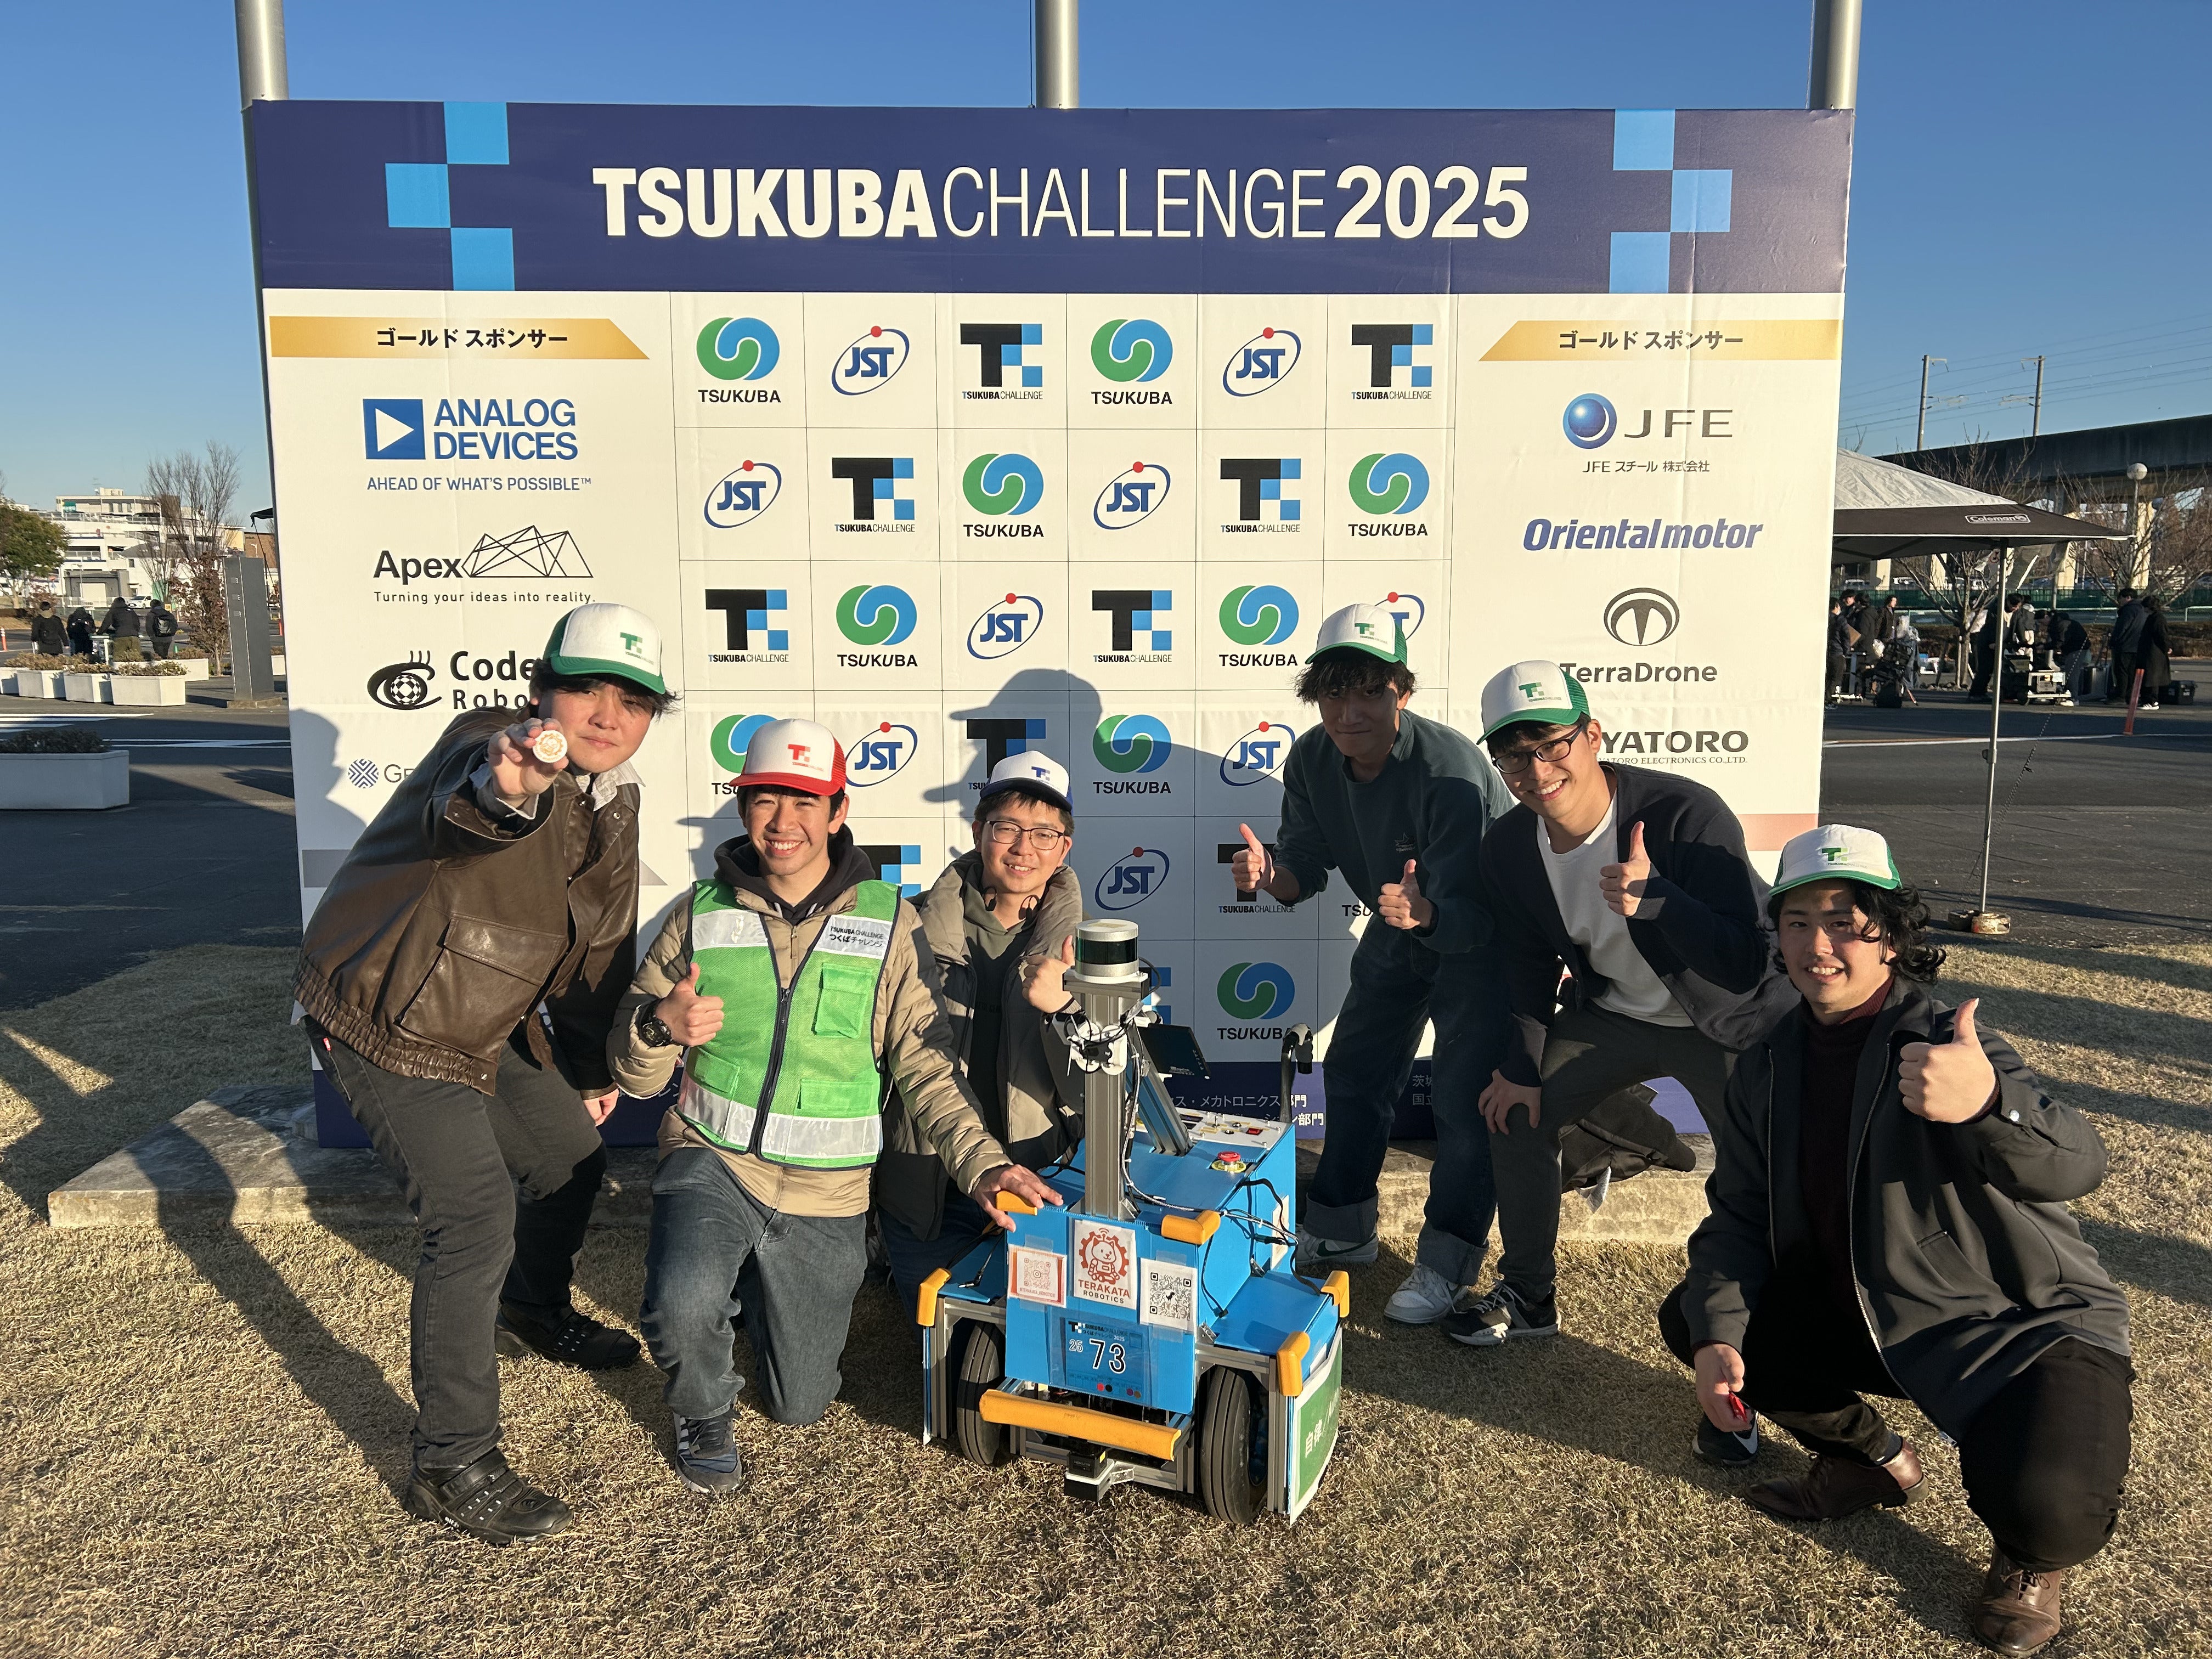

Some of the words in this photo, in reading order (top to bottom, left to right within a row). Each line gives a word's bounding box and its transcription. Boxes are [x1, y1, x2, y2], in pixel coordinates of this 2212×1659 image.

[1335, 165, 1528, 239] 2025
[845, 347, 894, 377] JST
[1236, 348, 1285, 379] JST
[698, 390, 781, 403] TSUKUBA
[1091, 392, 1172, 405] TSUKUBA
[434, 399, 575, 427] ANALOG
[1624, 410, 1733, 438] JFE
[434, 432, 578, 460] DEVICES
[1583, 462, 1610, 473] JFE
[1616, 462, 1657, 472] スチール
[1663, 461, 1709, 472] 株式会社
[368, 478, 417, 490] AHEAD
[423, 478, 442, 490] OF
[717, 481, 766, 511] JST
[1107, 483, 1155, 512] JST
[963, 525, 1043, 538] TSUKUBA
[1348, 524, 1427, 537] TSUKUBA
[374, 550, 462, 585] Apex
[374, 592, 427, 605] Turning
[435, 595, 464, 605] your
[471, 592, 507, 602] ideas
[514, 592, 539, 602] into
[980, 613, 1028, 642] JST
[450, 650, 534, 681] Code
[837, 655, 917, 667] TSUKUBA
[1219, 655, 1297, 667] TSUKUBA
[1560, 662, 1718, 682] TerraDrone
[854, 742, 902, 770] JST
[1233, 741, 1280, 769] JST
[1093, 782, 1171, 794] TSUKUBA
[1108, 866, 1154, 894] JST
[831, 926, 855, 934] TSUKUBA
[855, 929, 884, 939] CHALLENGE
[1079, 1279, 1130, 1298] TERAKATA
[1083, 1290, 1124, 1304] ROBOTICS
[1069, 1339, 1083, 1352] 25
[1090, 1339, 1125, 1374] 73
